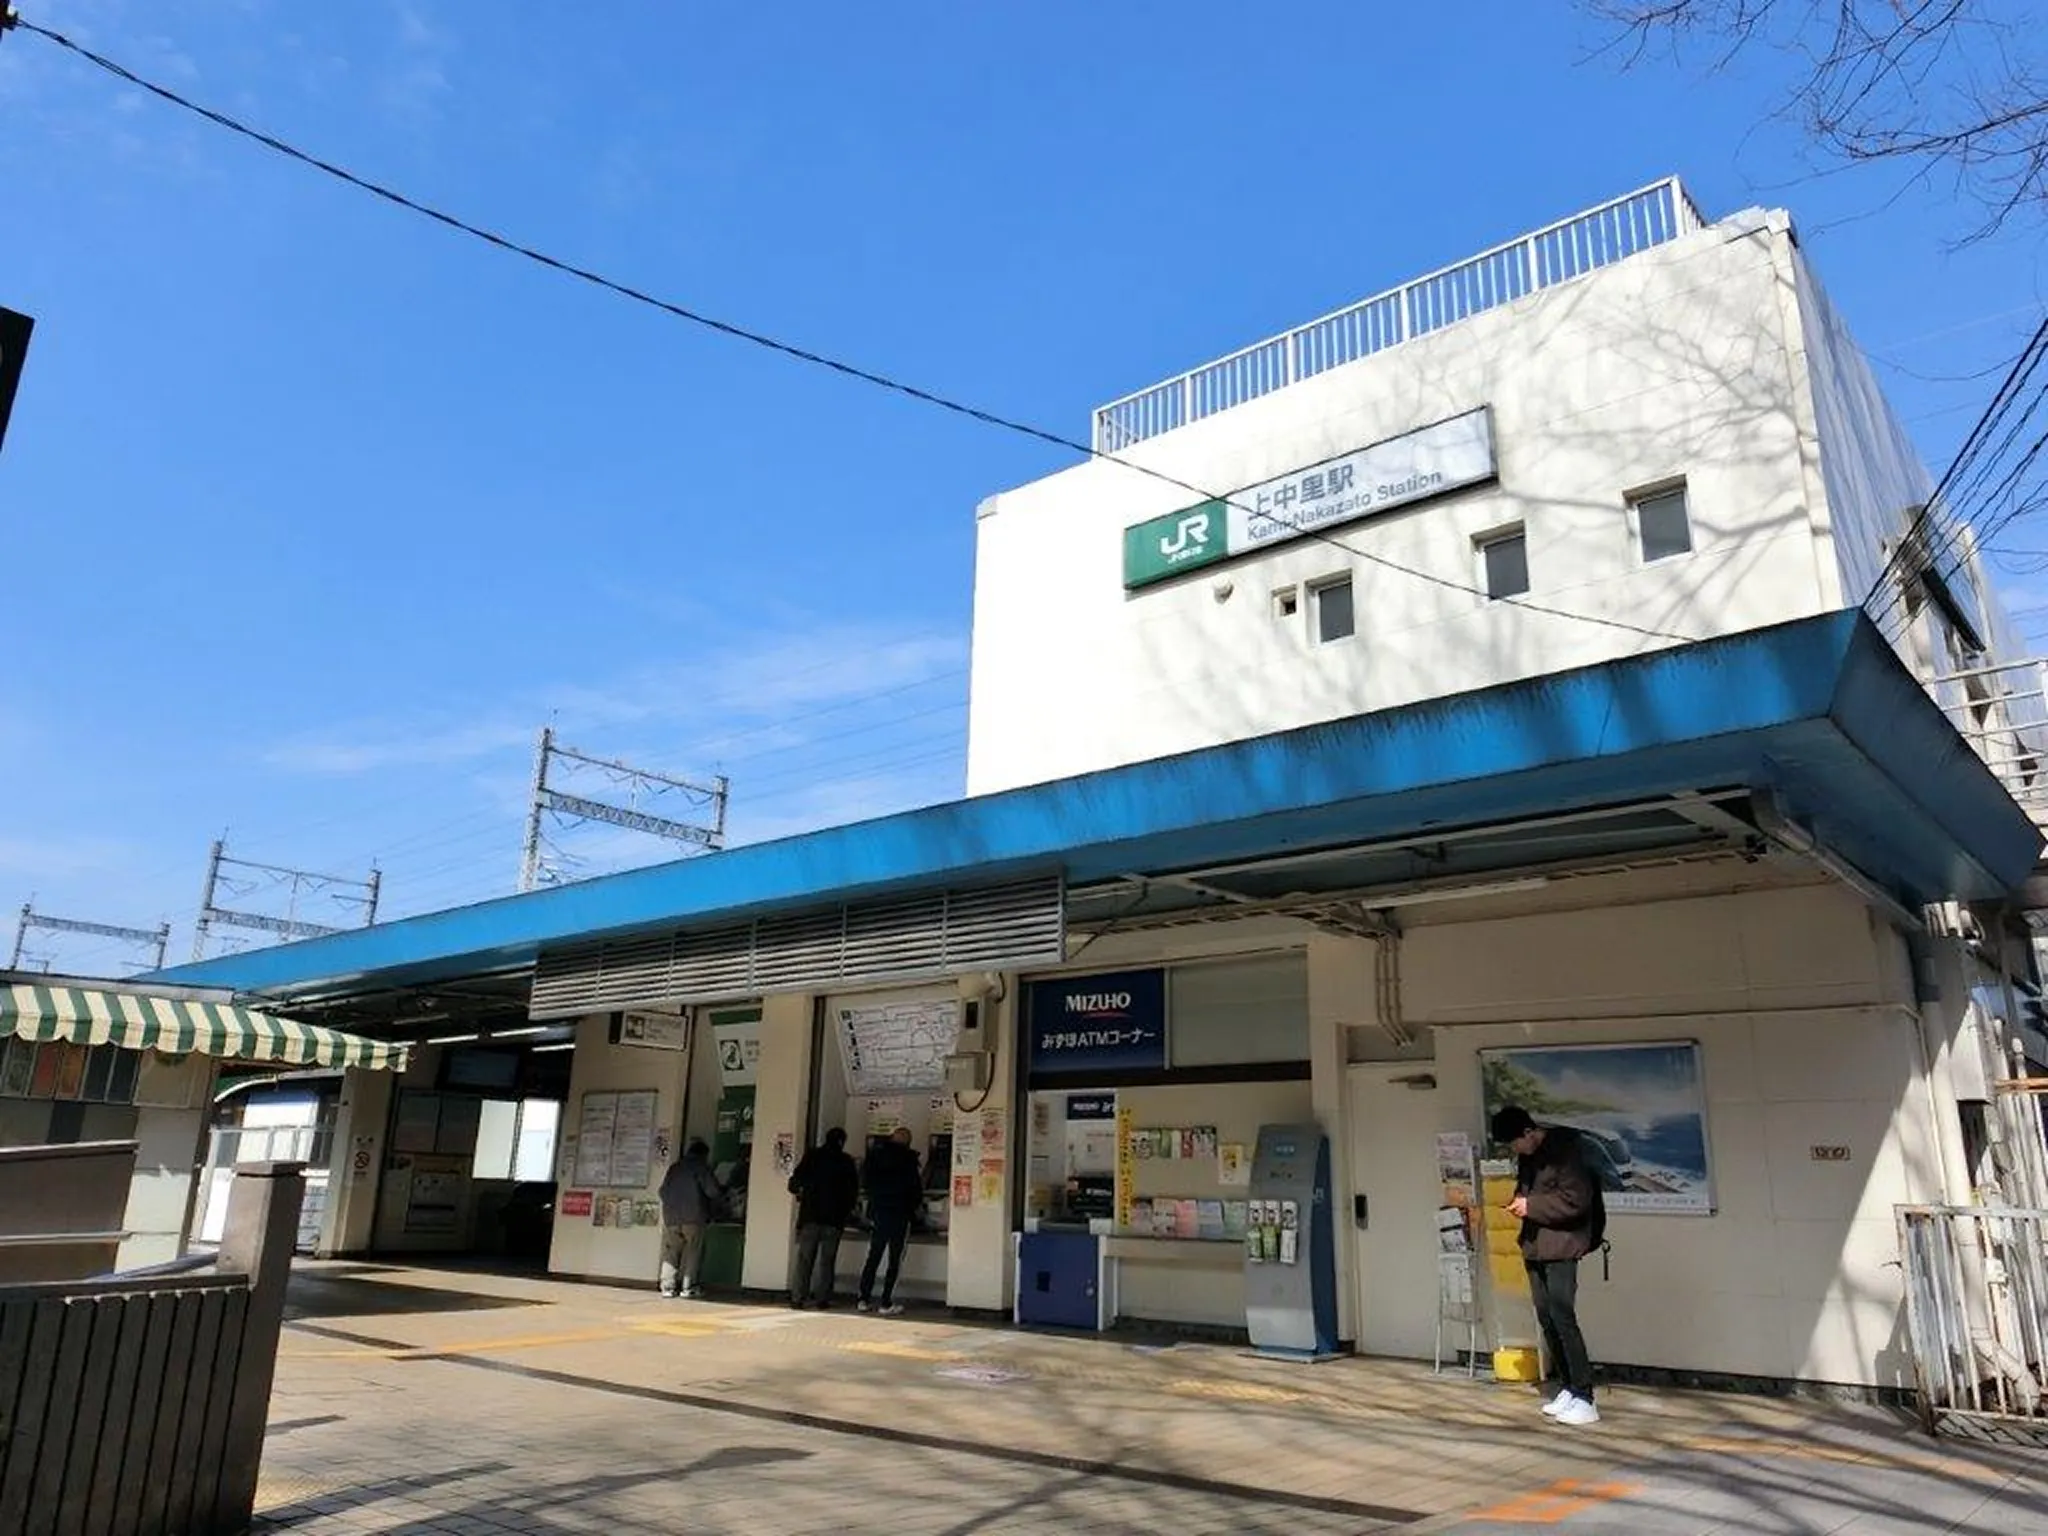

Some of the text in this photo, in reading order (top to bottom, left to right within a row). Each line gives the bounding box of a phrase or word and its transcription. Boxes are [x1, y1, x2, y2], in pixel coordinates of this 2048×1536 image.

[1248, 464, 1354, 521] 上中里駅
[1377, 471, 1442, 500] Station
[1160, 514, 1209, 555] JR
[1065, 992, 1131, 1012] MIZUHO
[1042, 1027, 1156, 1049] みずほATMコーナー
